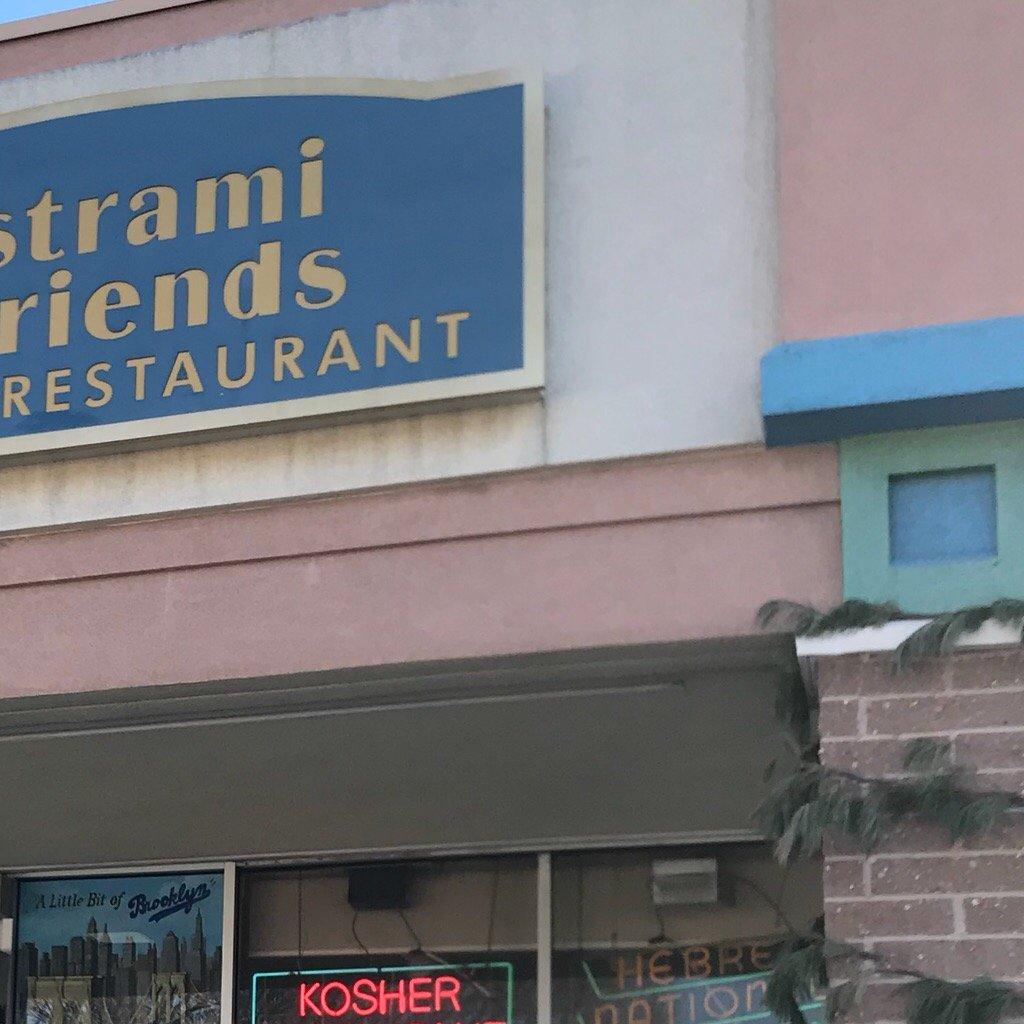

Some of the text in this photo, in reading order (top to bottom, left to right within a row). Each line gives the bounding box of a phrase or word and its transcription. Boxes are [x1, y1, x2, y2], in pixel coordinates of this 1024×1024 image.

[2, 311, 470, 418] RESTAURANT
[50, 893, 85, 909] Little
[87, 892, 105, 908] Bit
[110, 891, 126, 910] of
[618, 945, 773, 989] HEBRE
[297, 976, 462, 1017] KOSHER
